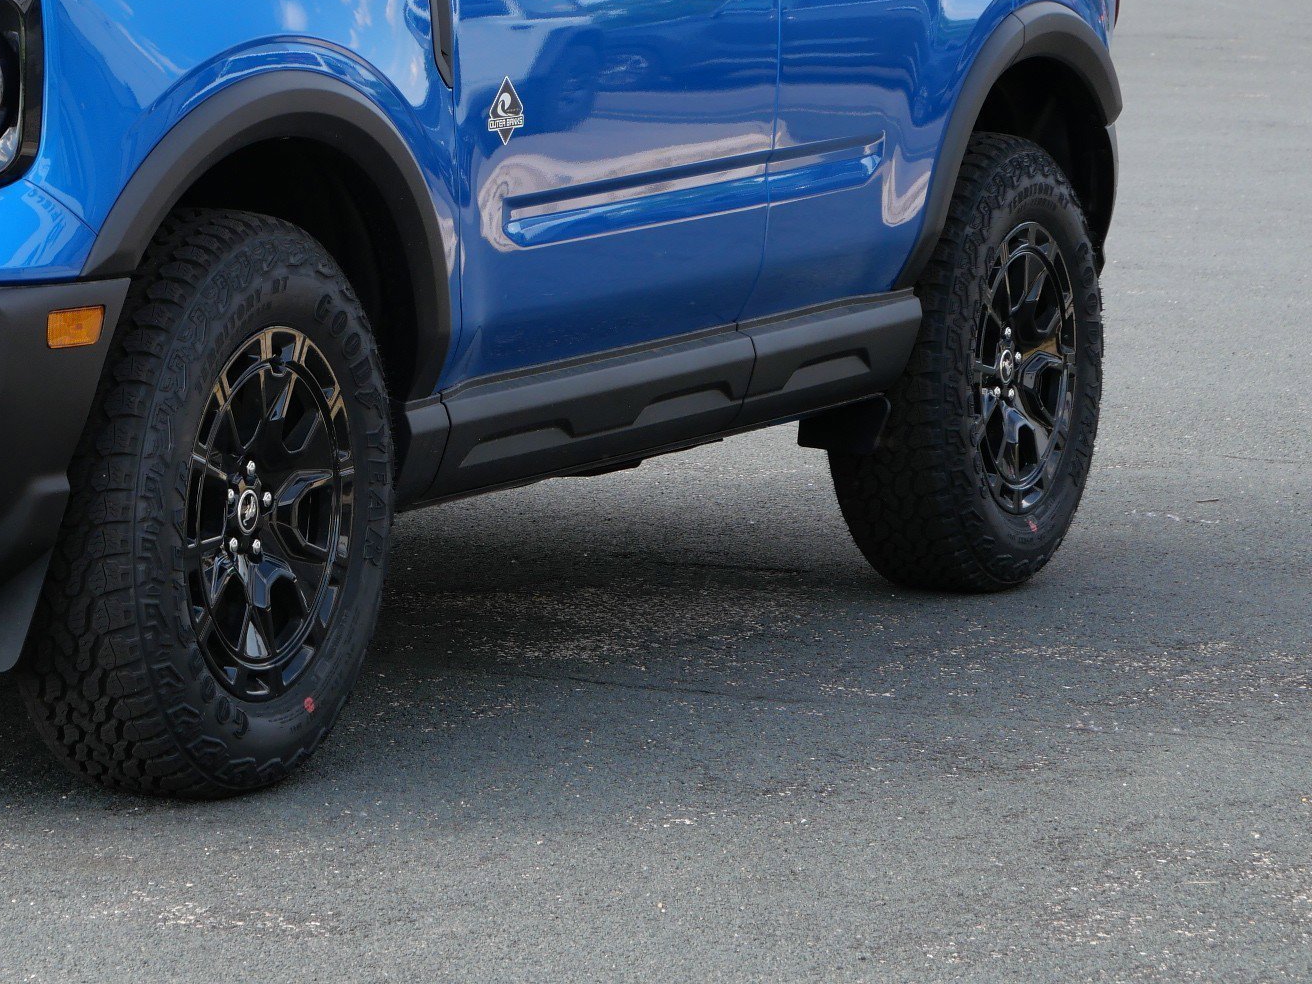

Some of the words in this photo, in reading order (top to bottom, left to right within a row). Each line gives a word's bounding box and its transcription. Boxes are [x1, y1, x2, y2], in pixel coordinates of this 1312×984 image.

[489, 119, 506, 129] OUTER
[506, 116, 523, 127] BANKS
[314, 293, 388, 566] GOODYEAR
